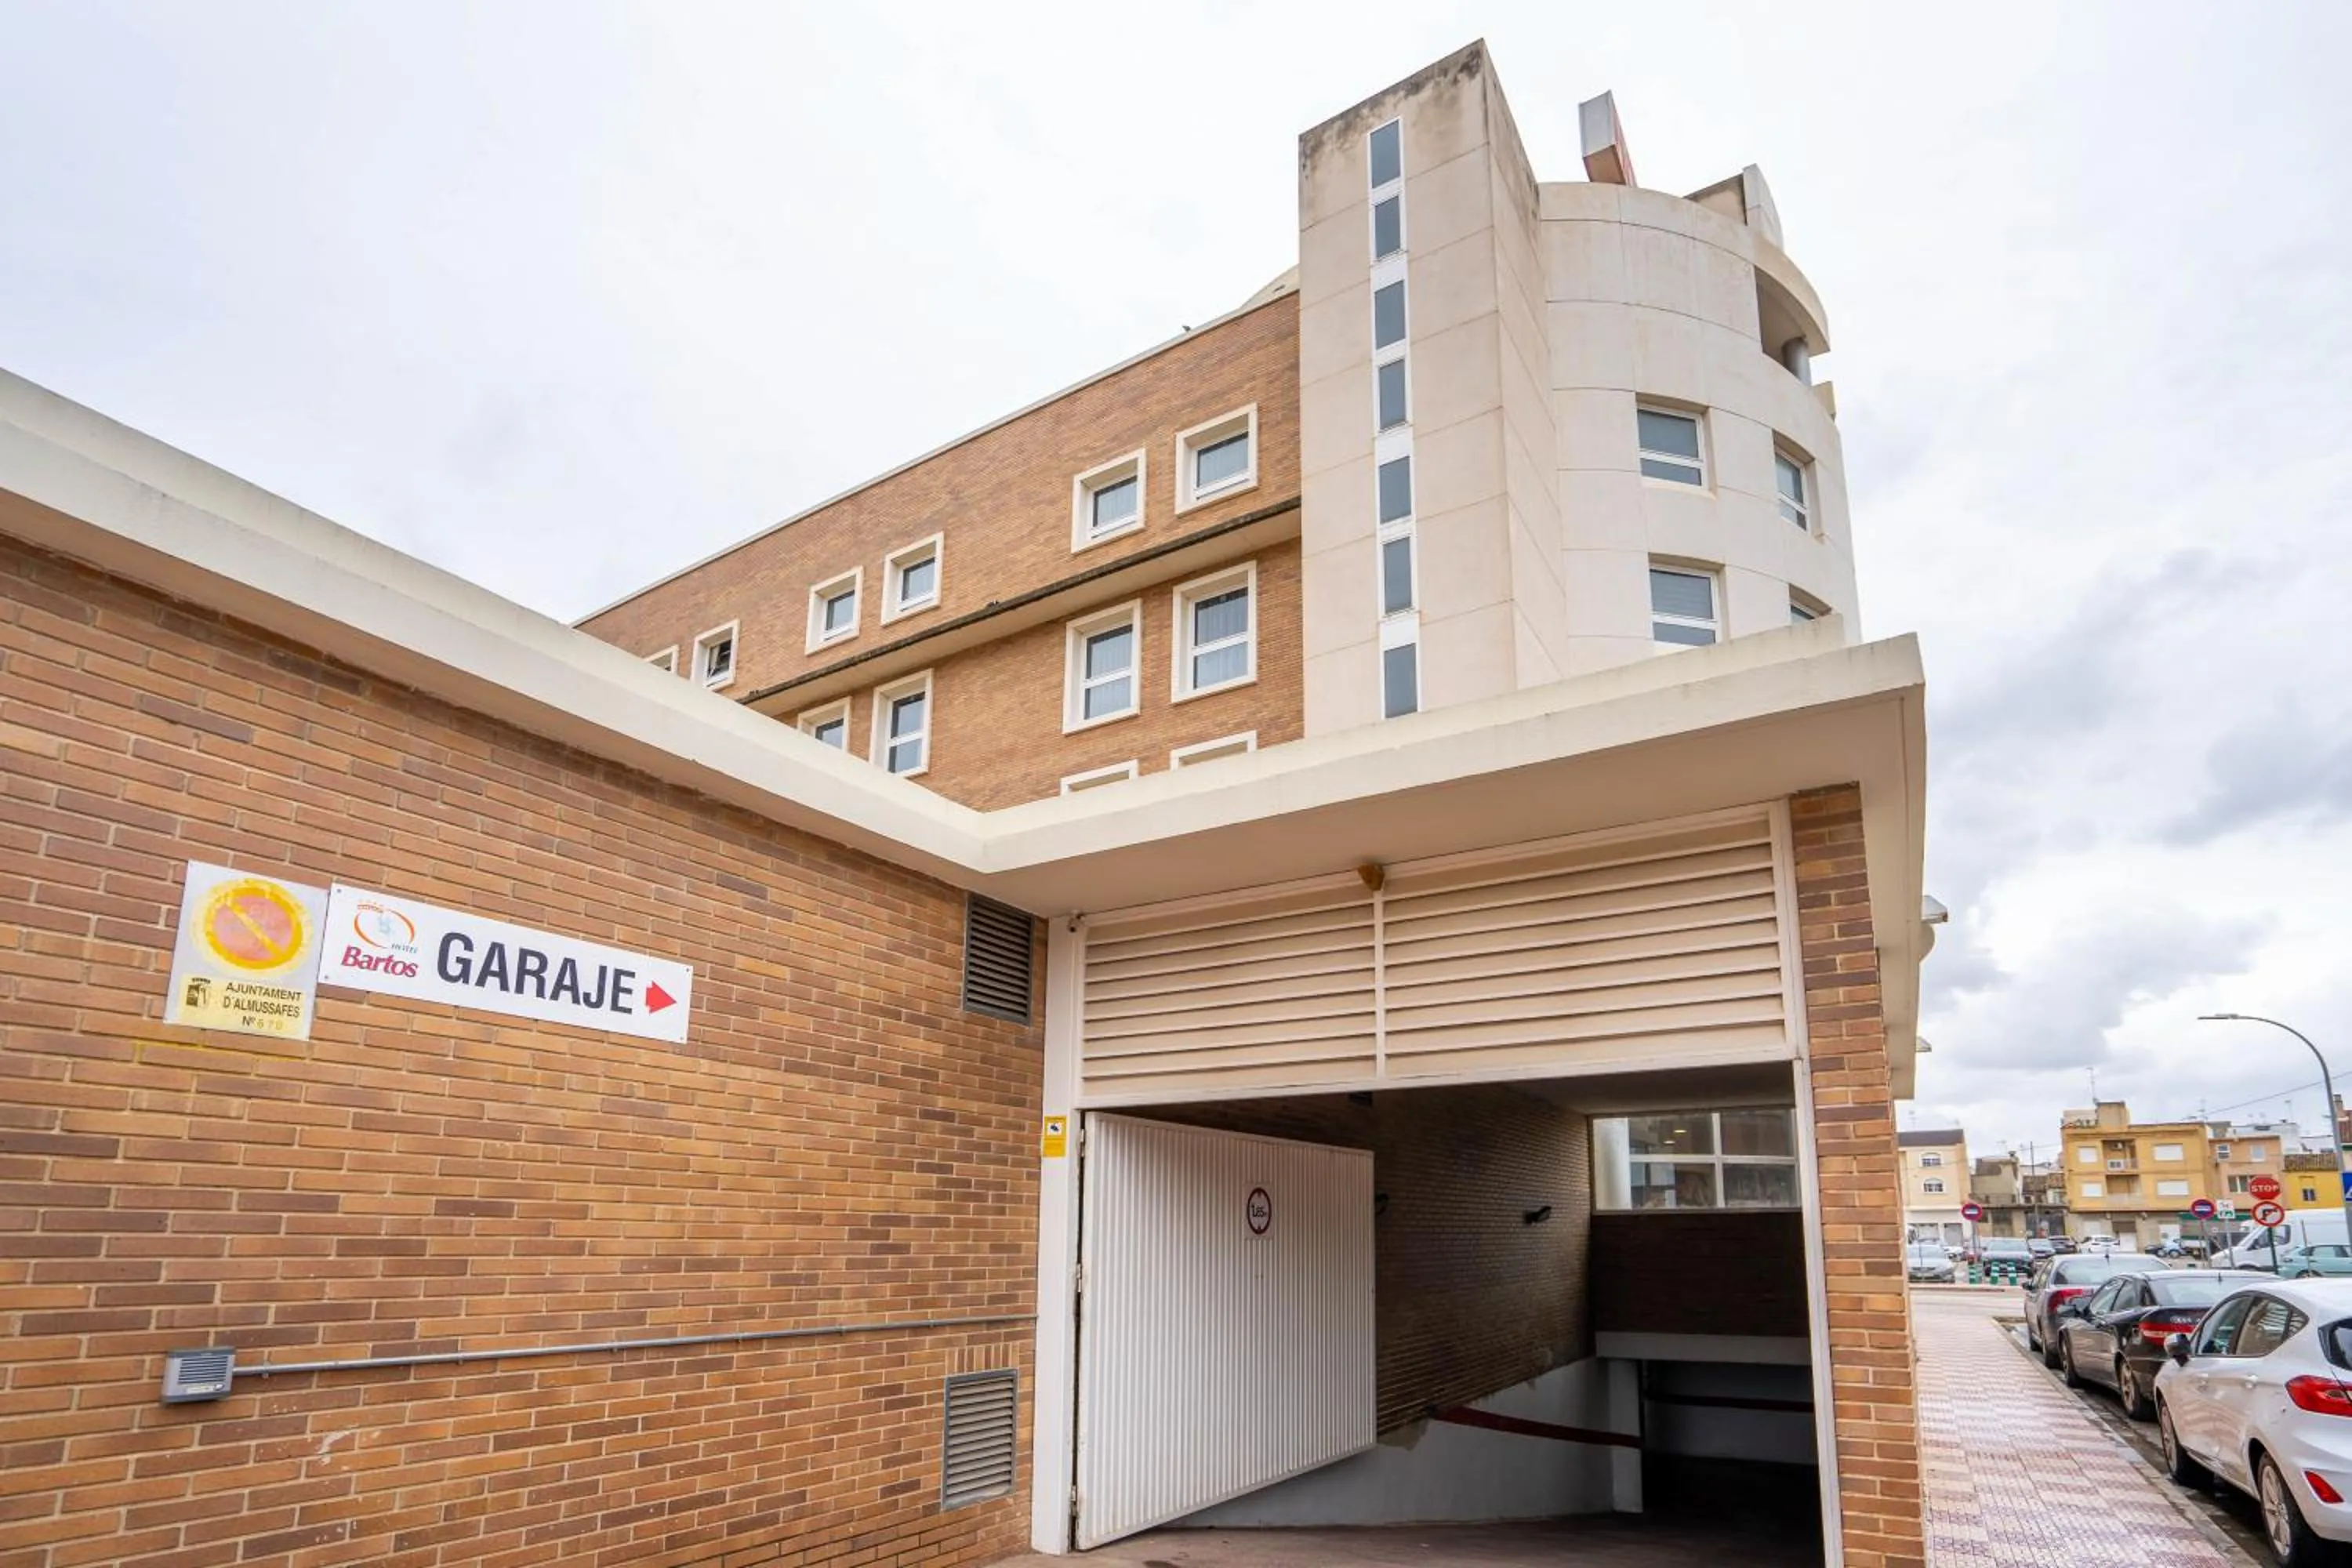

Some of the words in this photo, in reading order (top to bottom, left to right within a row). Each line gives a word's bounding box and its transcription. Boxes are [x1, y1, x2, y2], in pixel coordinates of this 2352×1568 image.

[341, 945, 419, 978] Bartos
[437, 931, 636, 1015] GARAJE
[225, 982, 302, 1002] AJUNTAMENT
[2251, 1184, 2279, 1192] STOP
